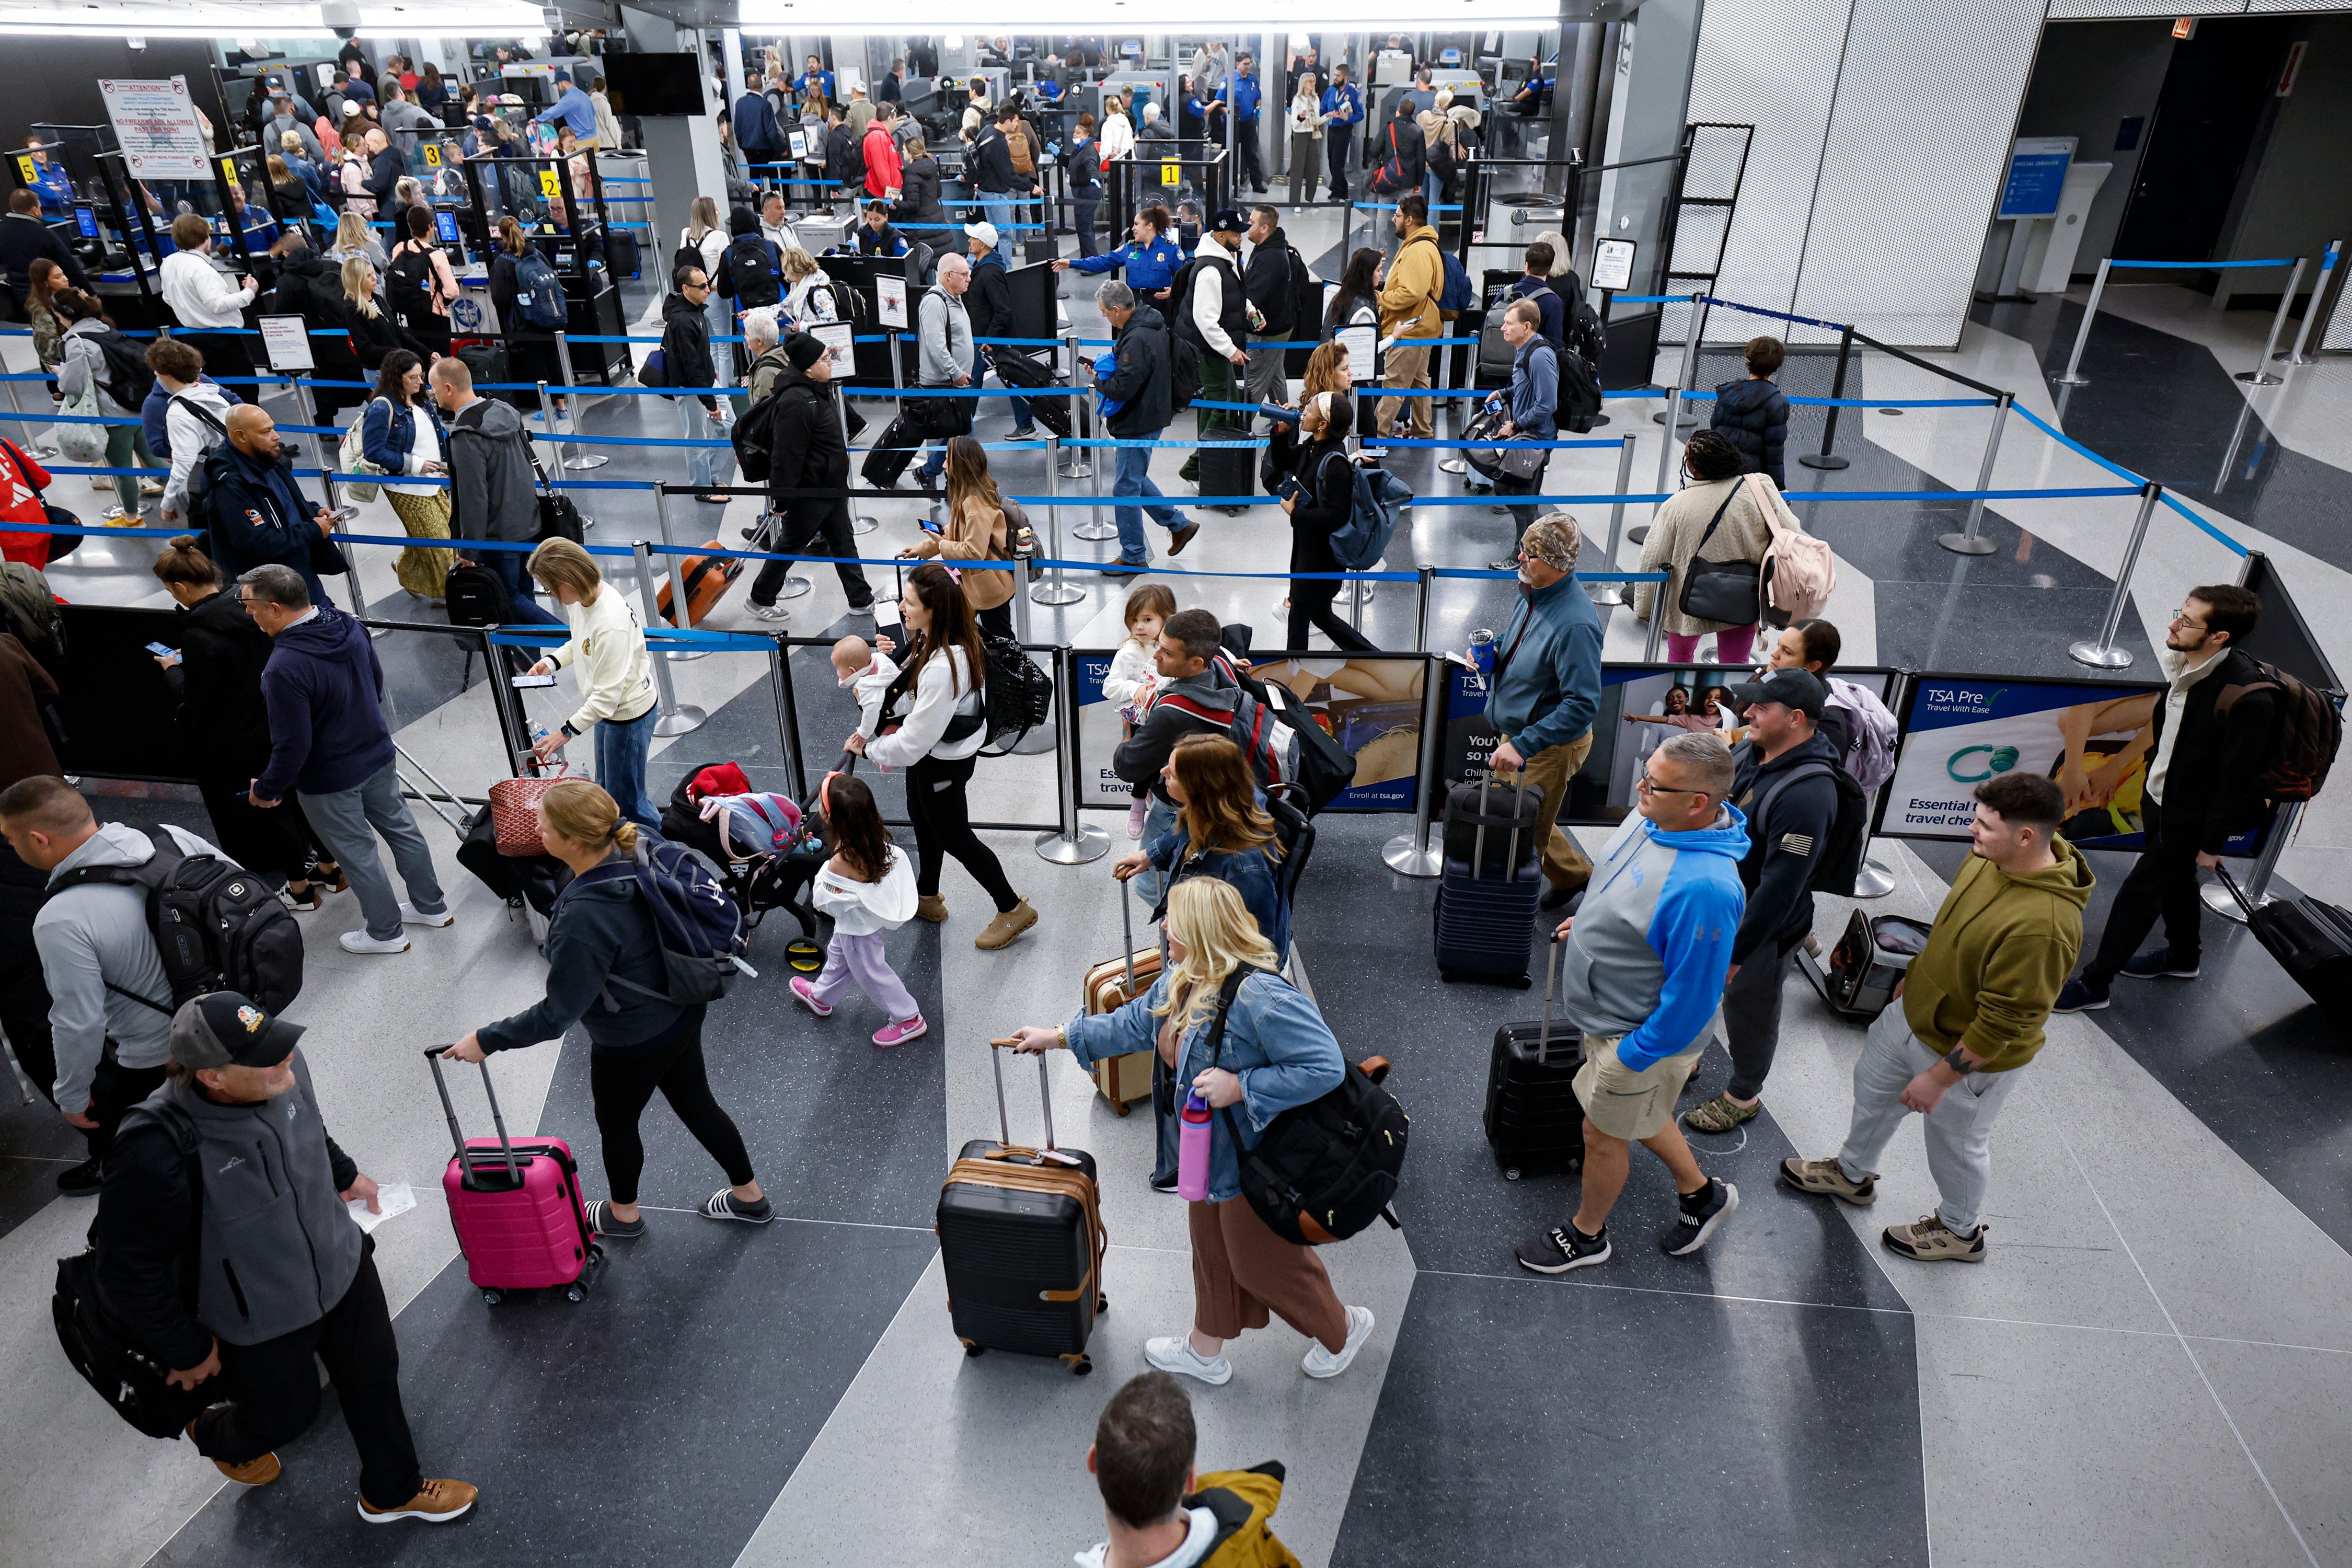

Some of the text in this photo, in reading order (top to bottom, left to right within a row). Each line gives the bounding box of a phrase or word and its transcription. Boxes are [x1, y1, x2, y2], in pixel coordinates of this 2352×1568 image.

[426, 146, 437, 164] 3
[22, 164, 34, 181] 5
[227, 166, 235, 183] 4
[1166, 166, 1175, 183] 1
[545, 179, 557, 195] 2
[1086, 664, 1110, 675] TSA
[1929, 689, 1983, 704] TSA Pre
[1467, 752, 1482, 761] so
[1909, 798, 1970, 812] Essential
[1905, 813, 1946, 825] travel
